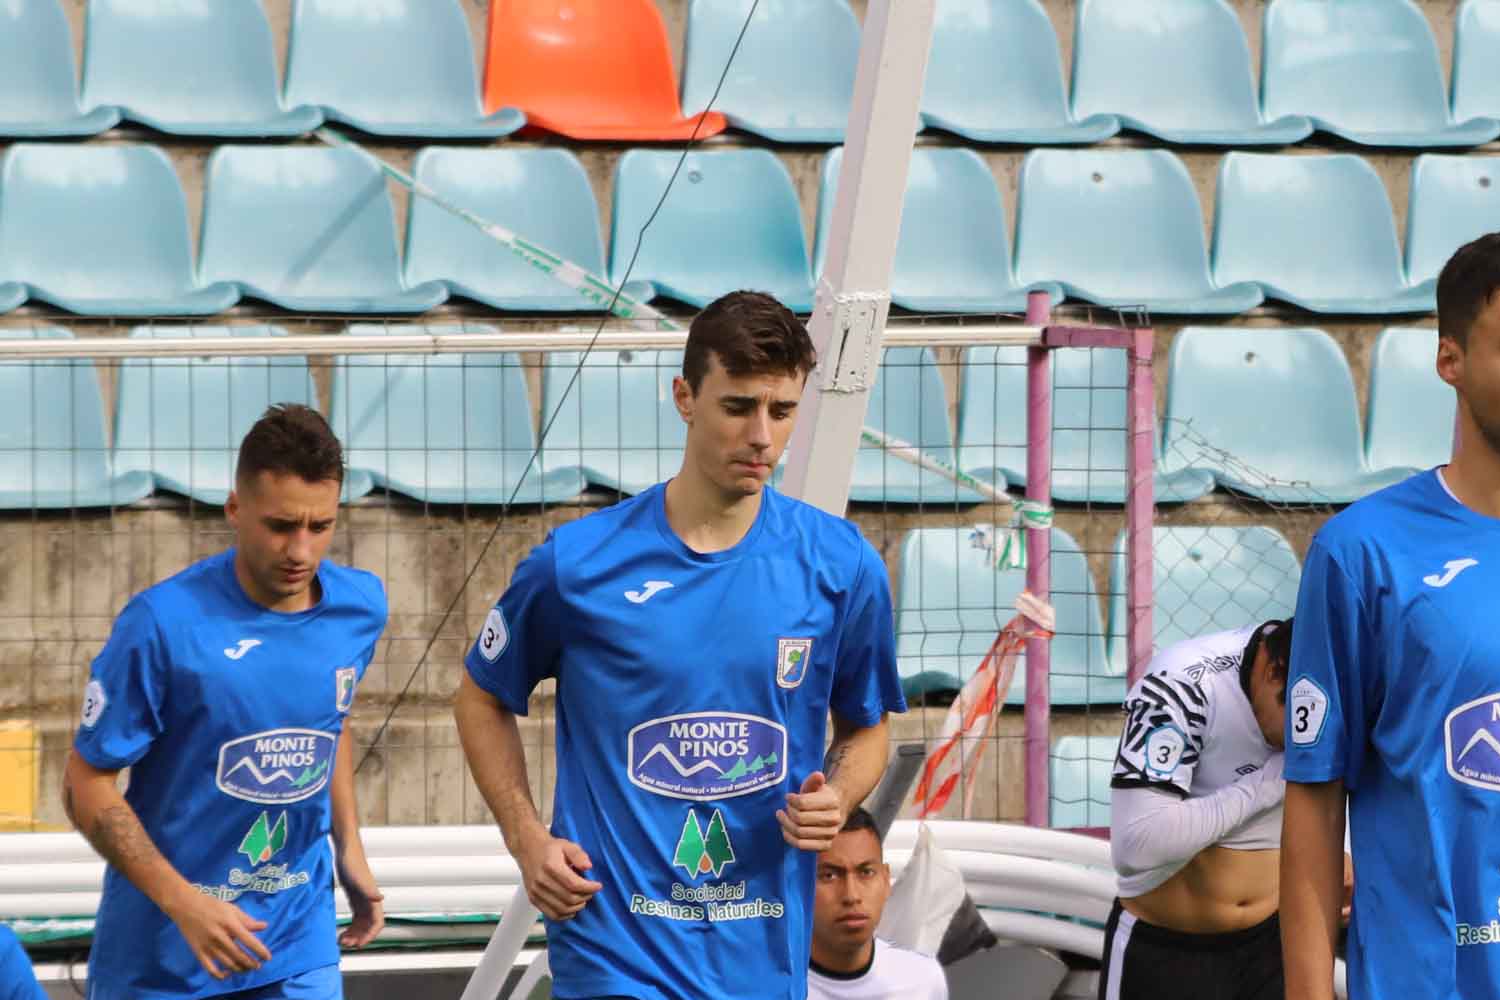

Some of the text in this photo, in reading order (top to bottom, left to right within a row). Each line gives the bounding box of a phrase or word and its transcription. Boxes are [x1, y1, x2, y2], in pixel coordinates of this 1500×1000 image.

[669, 721, 750, 738] MONTE
[255, 736, 317, 752] MONTE
[679, 739, 749, 757] PINOS
[260, 751, 314, 768] PINOS
[672, 880, 745, 902] Sociedad
[631, 894, 784, 922] Resinas Naturales
